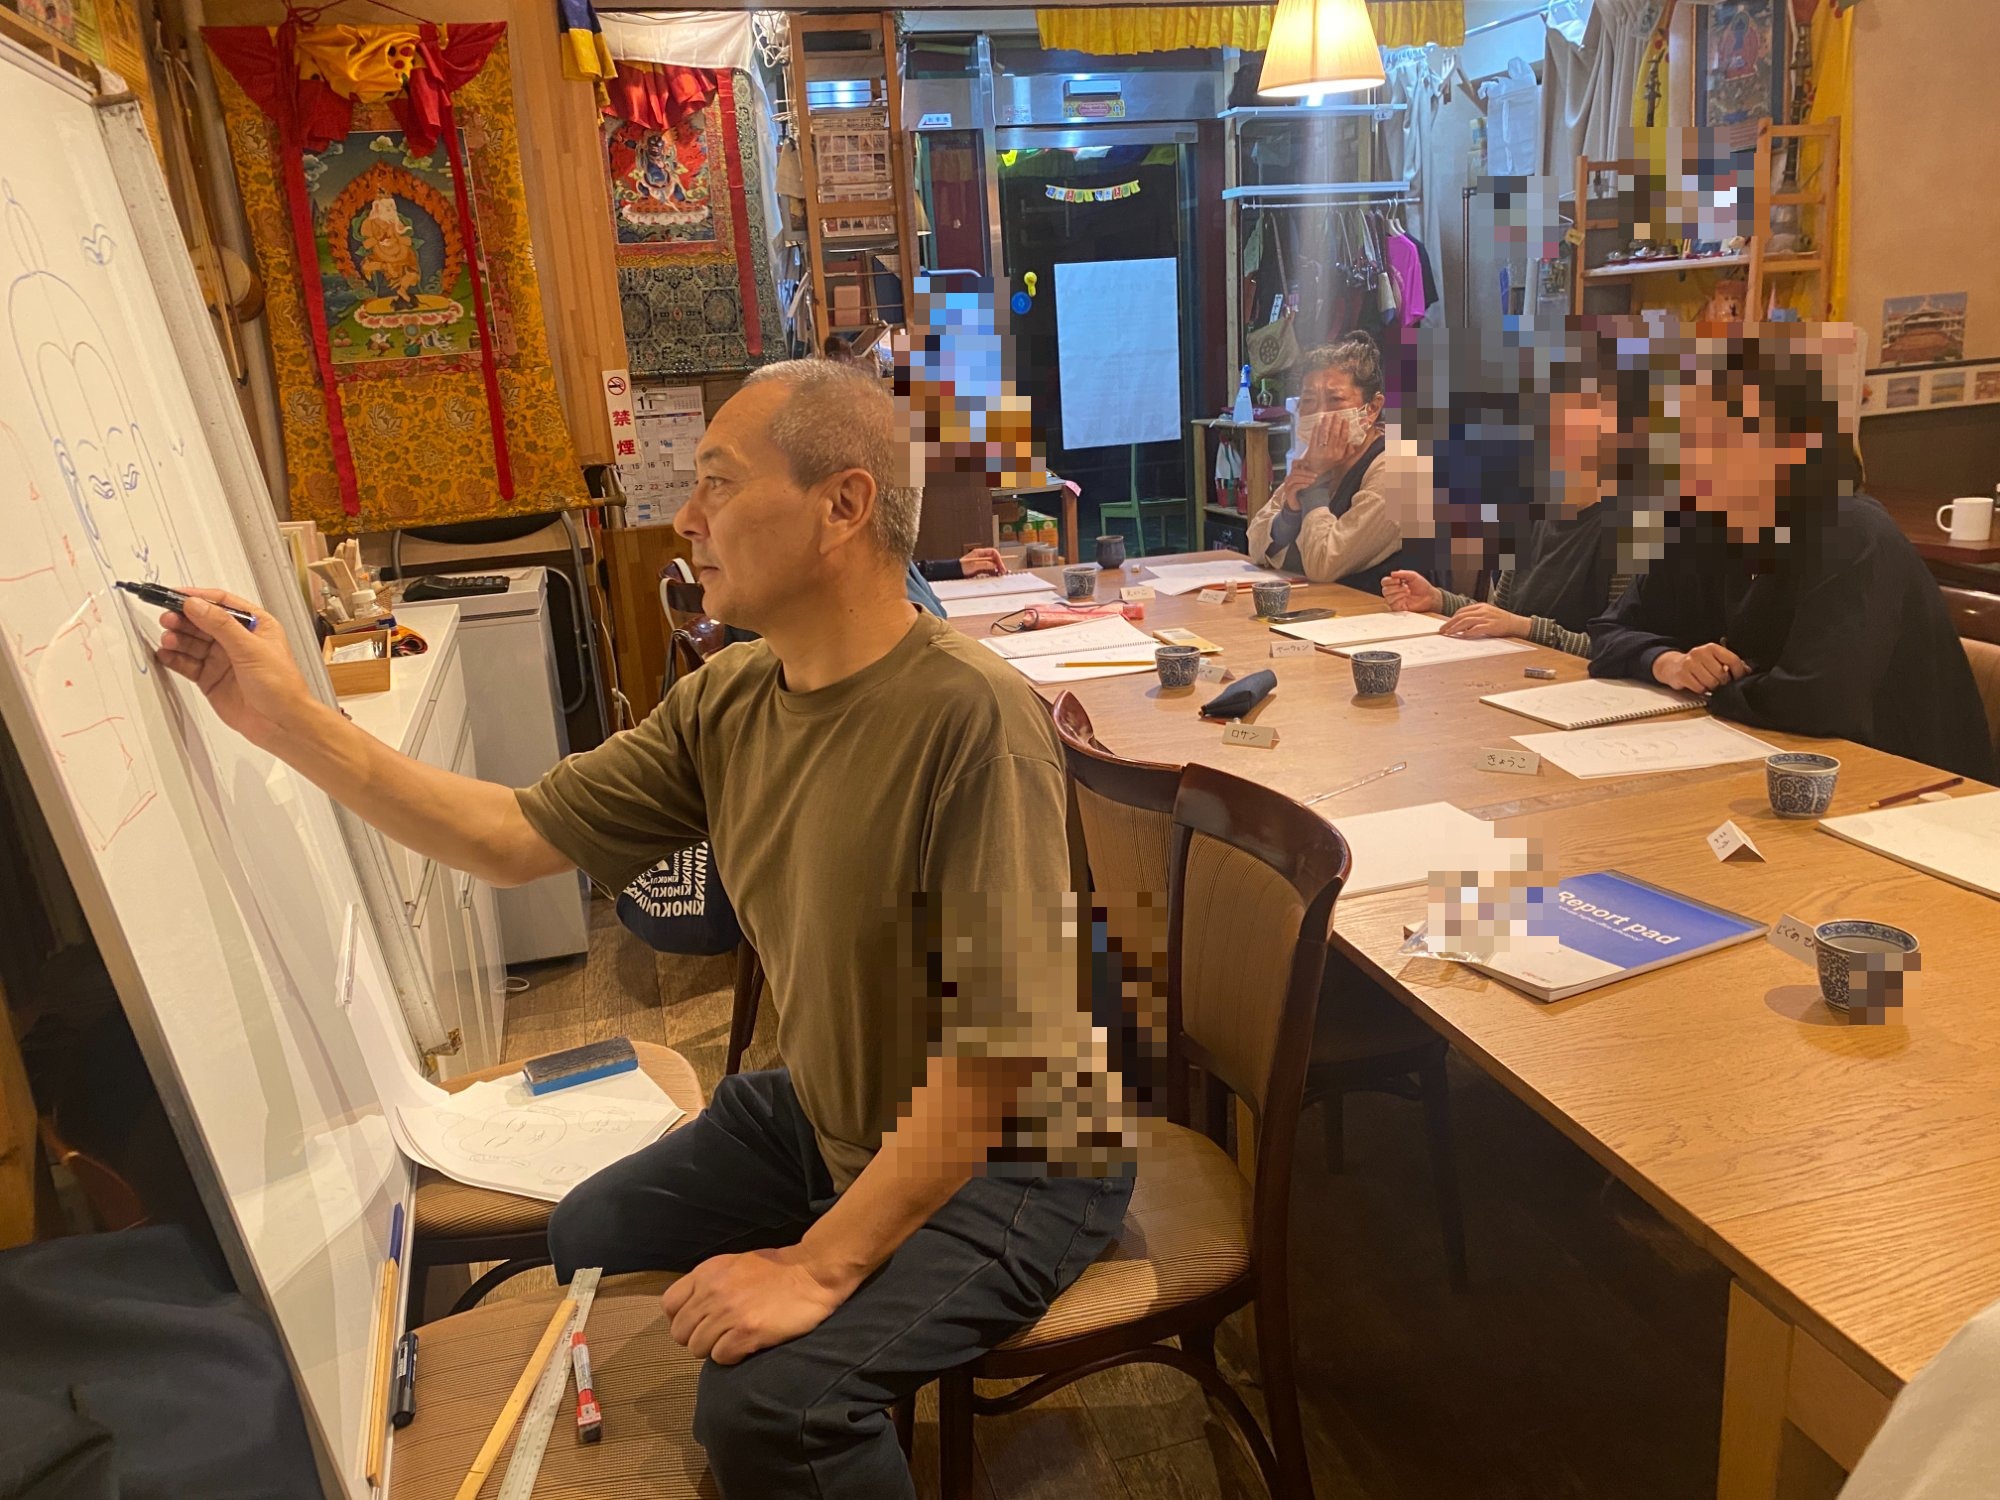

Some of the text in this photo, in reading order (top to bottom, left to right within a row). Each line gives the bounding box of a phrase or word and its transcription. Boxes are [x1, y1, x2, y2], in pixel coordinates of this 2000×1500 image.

[637, 396, 653, 410] 11
[612, 410, 636, 456] 禁煙
[1231, 729, 1259, 740] ロサン
[1487, 754, 1526, 769] きょうこ
[1558, 890, 1630, 926] Report
[1622, 919, 1681, 945] pad
